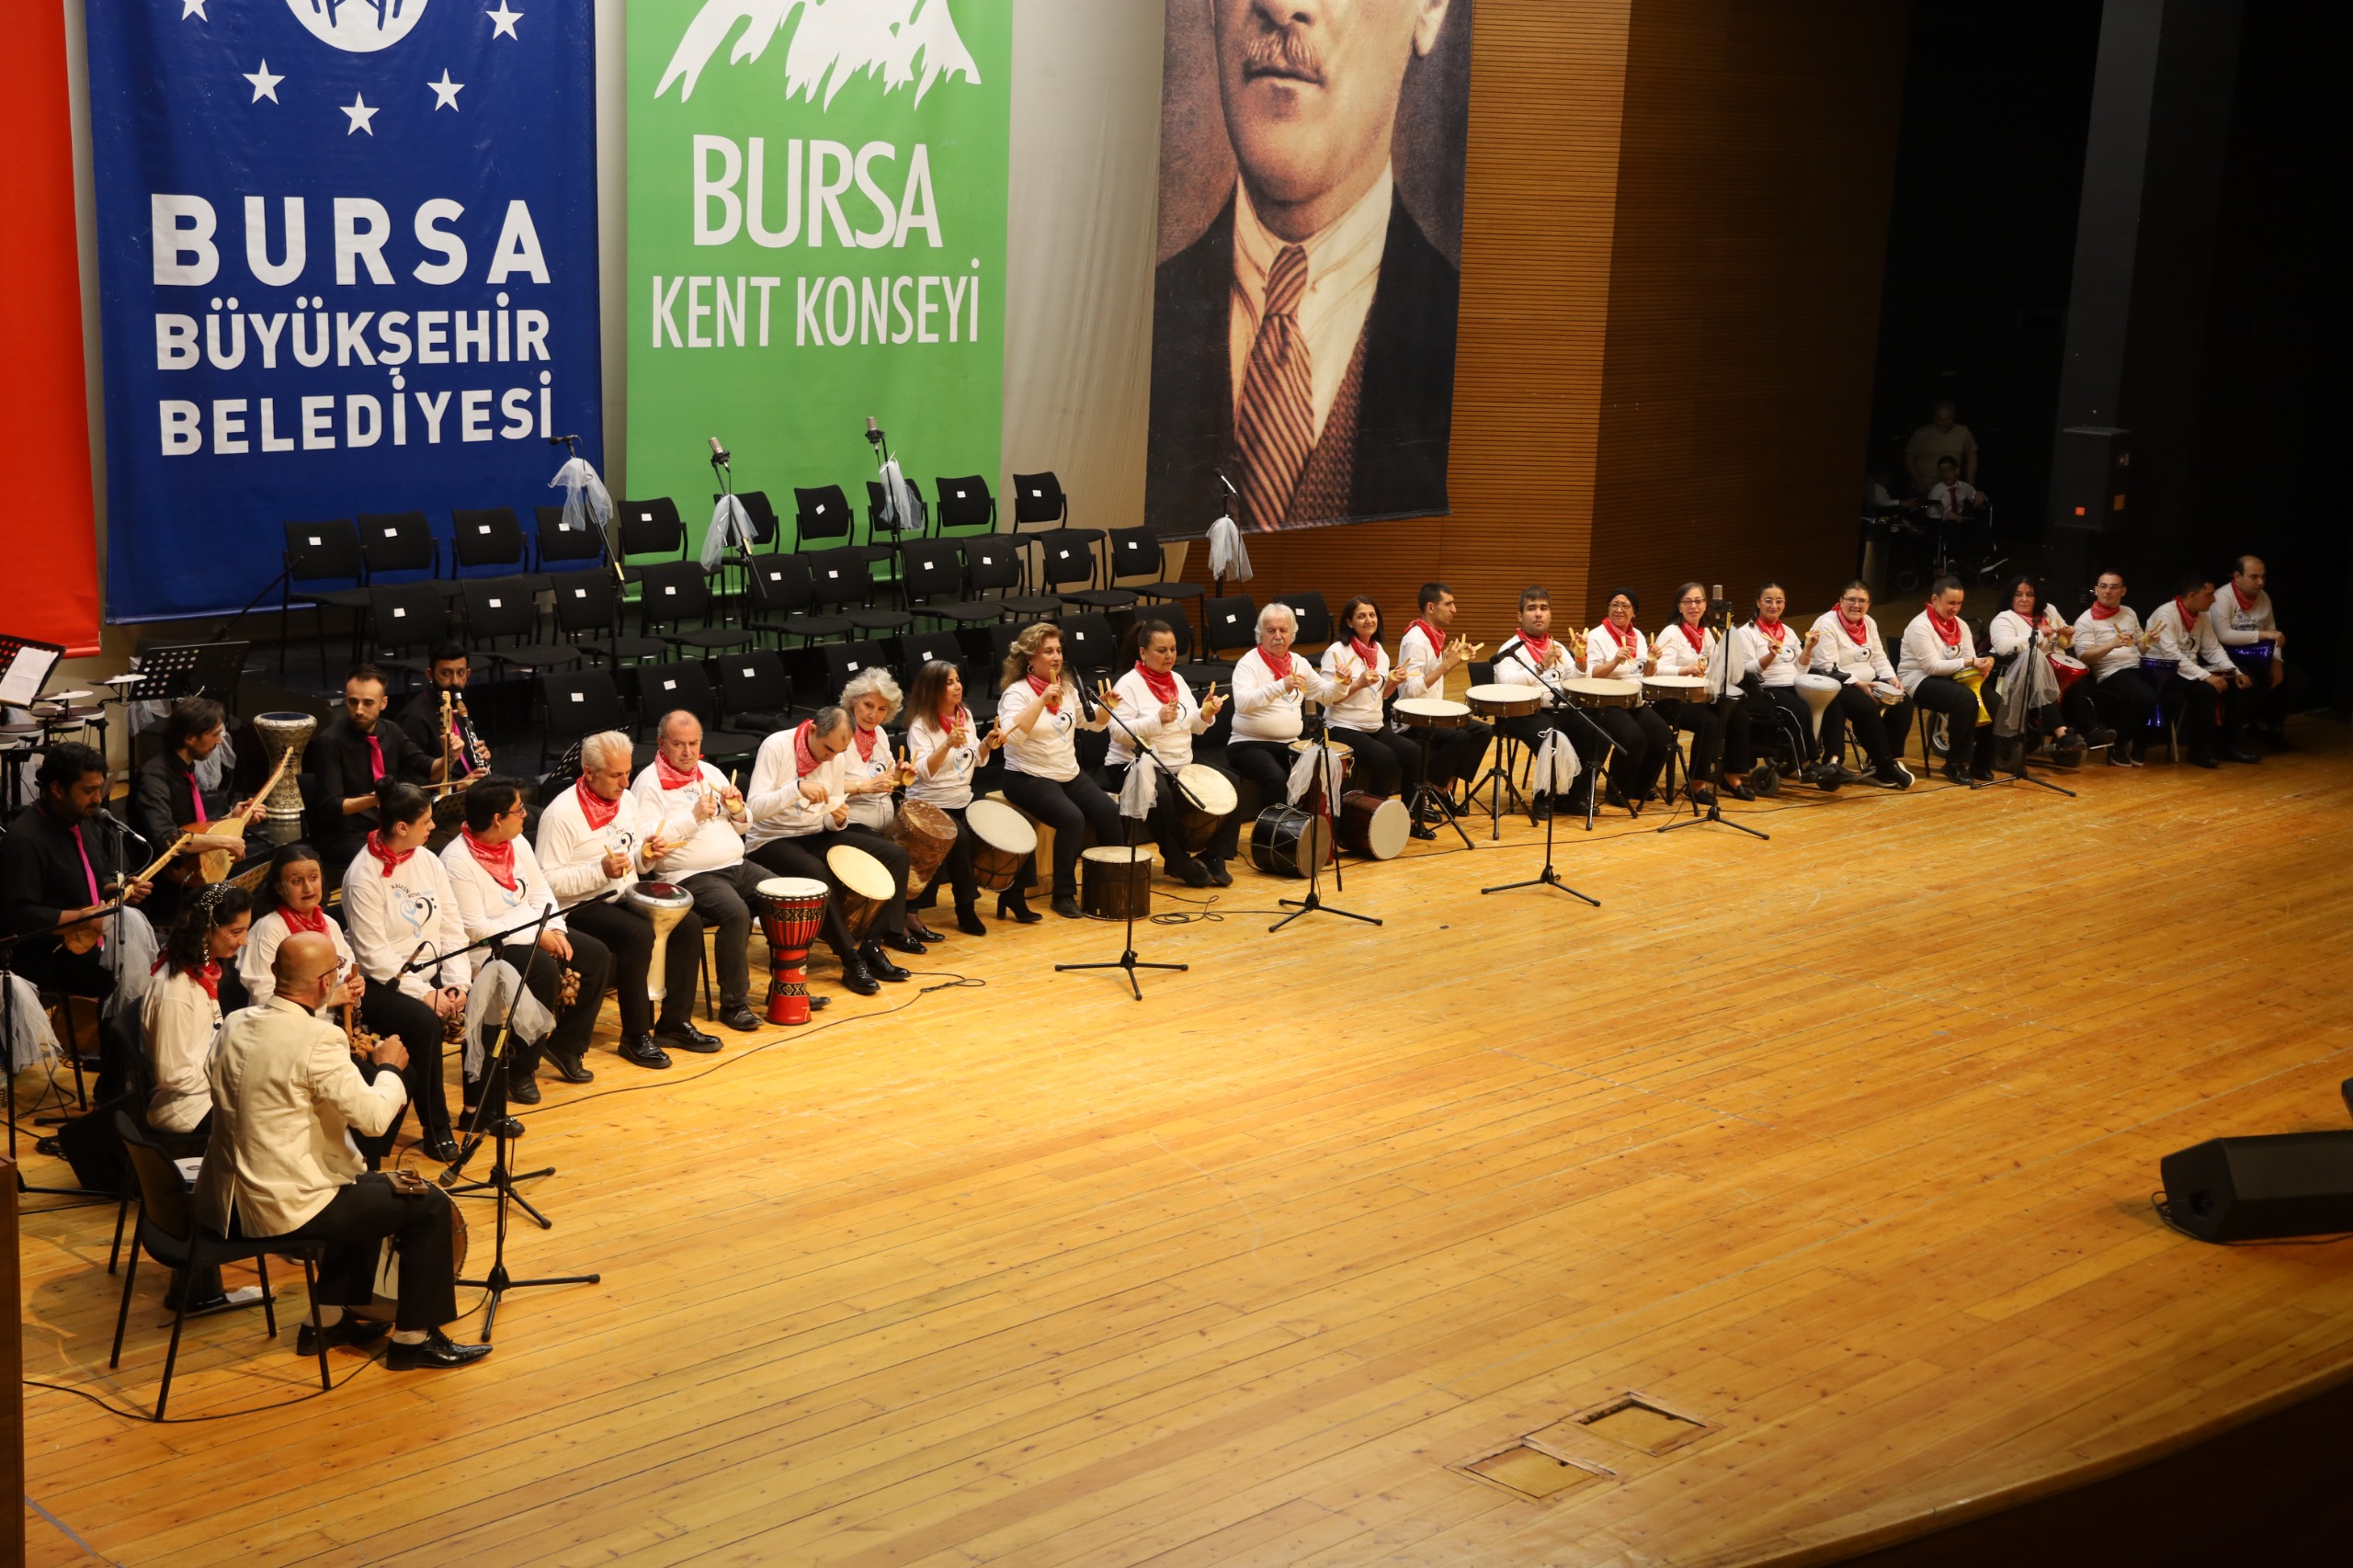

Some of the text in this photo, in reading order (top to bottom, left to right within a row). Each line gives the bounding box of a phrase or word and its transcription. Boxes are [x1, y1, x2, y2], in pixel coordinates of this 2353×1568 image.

[693, 134, 943, 249] BURSA
[151, 194, 551, 287] BURSA
[155, 292, 551, 376] BÜYÜKŞEHİR
[652, 258, 980, 348] KENT KONSEYİ
[160, 370, 552, 457] BELEDİYESİ
